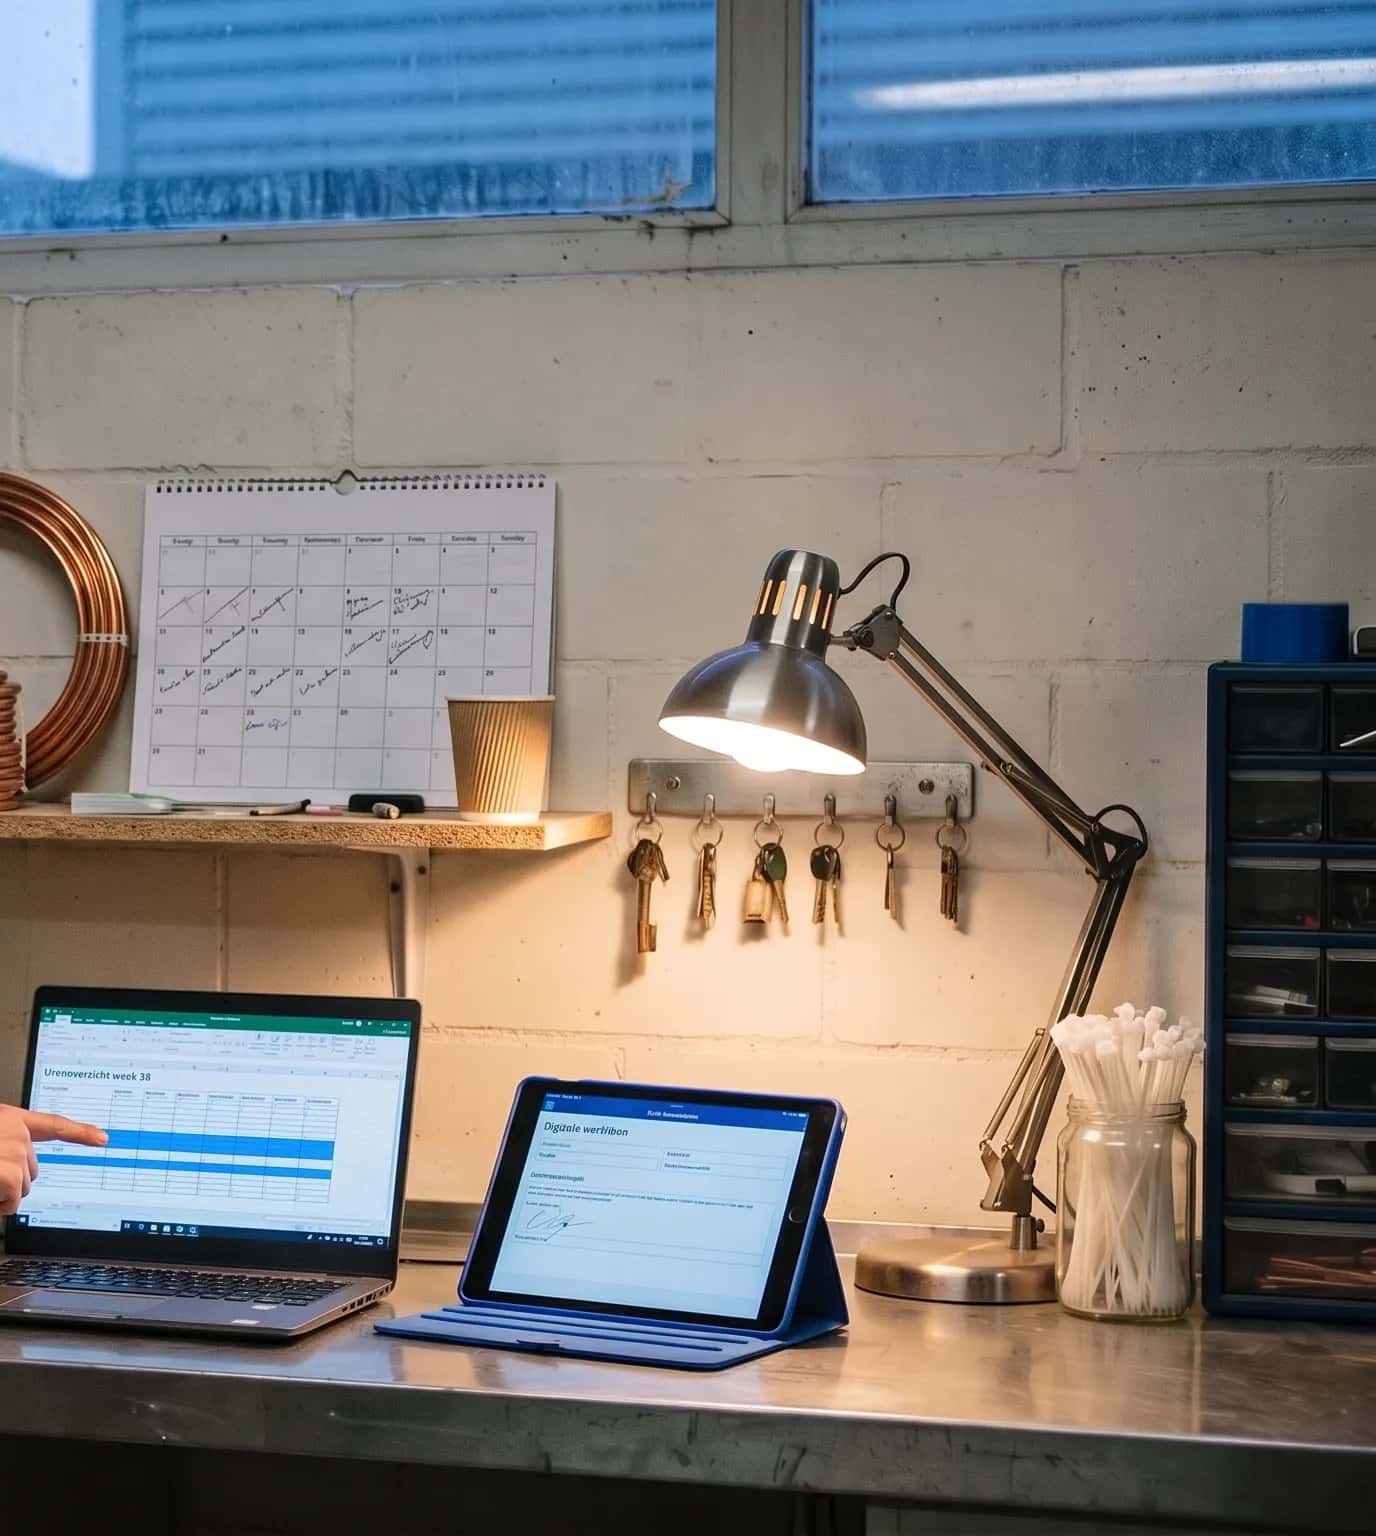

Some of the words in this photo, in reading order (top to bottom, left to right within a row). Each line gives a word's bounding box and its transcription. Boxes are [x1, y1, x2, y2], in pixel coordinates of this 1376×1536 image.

[44, 1068, 111, 1080] Urenoverzicht
[112, 1071, 137, 1081] week
[139, 1072, 151, 1081] 38
